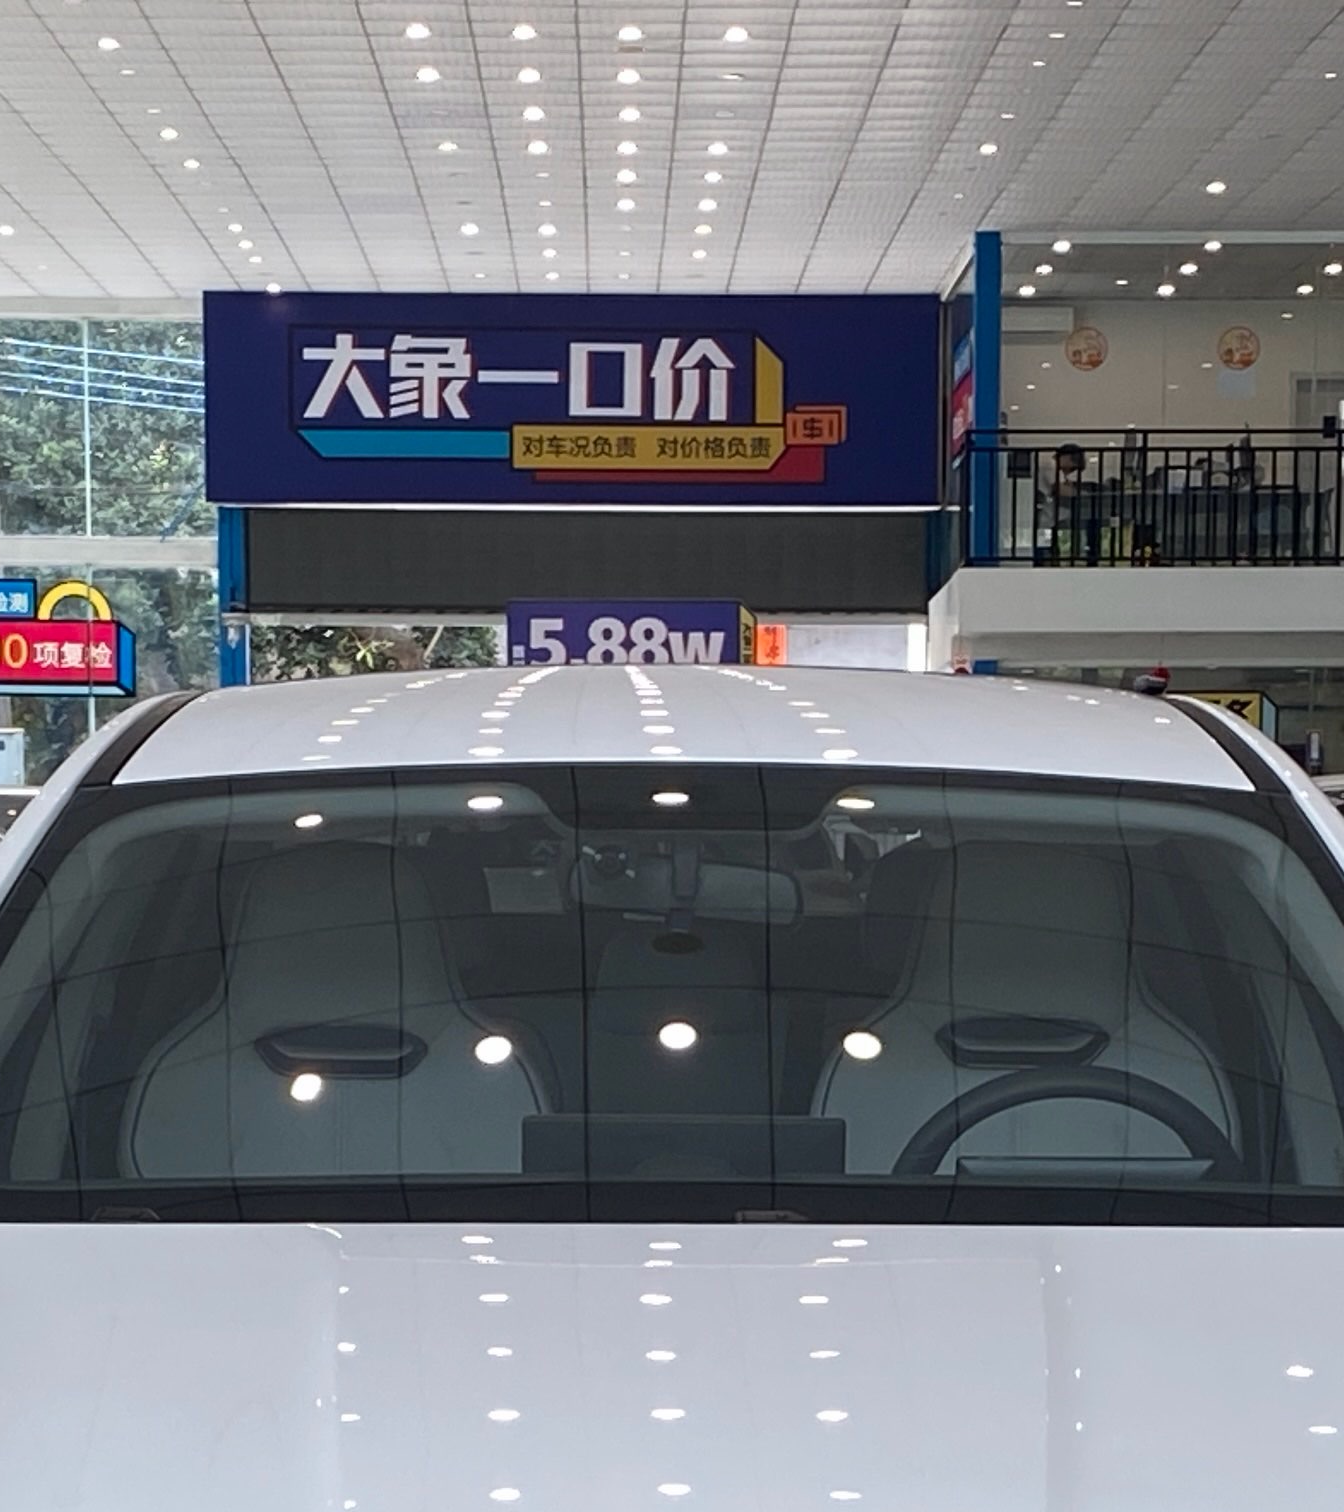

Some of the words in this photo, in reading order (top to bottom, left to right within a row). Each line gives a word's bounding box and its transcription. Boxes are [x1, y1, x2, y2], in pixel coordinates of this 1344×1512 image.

[302, 333, 736, 422] 大象一口价
[522, 438, 637, 459] 对车况负责
[657, 438, 772, 459] 对价格负责
